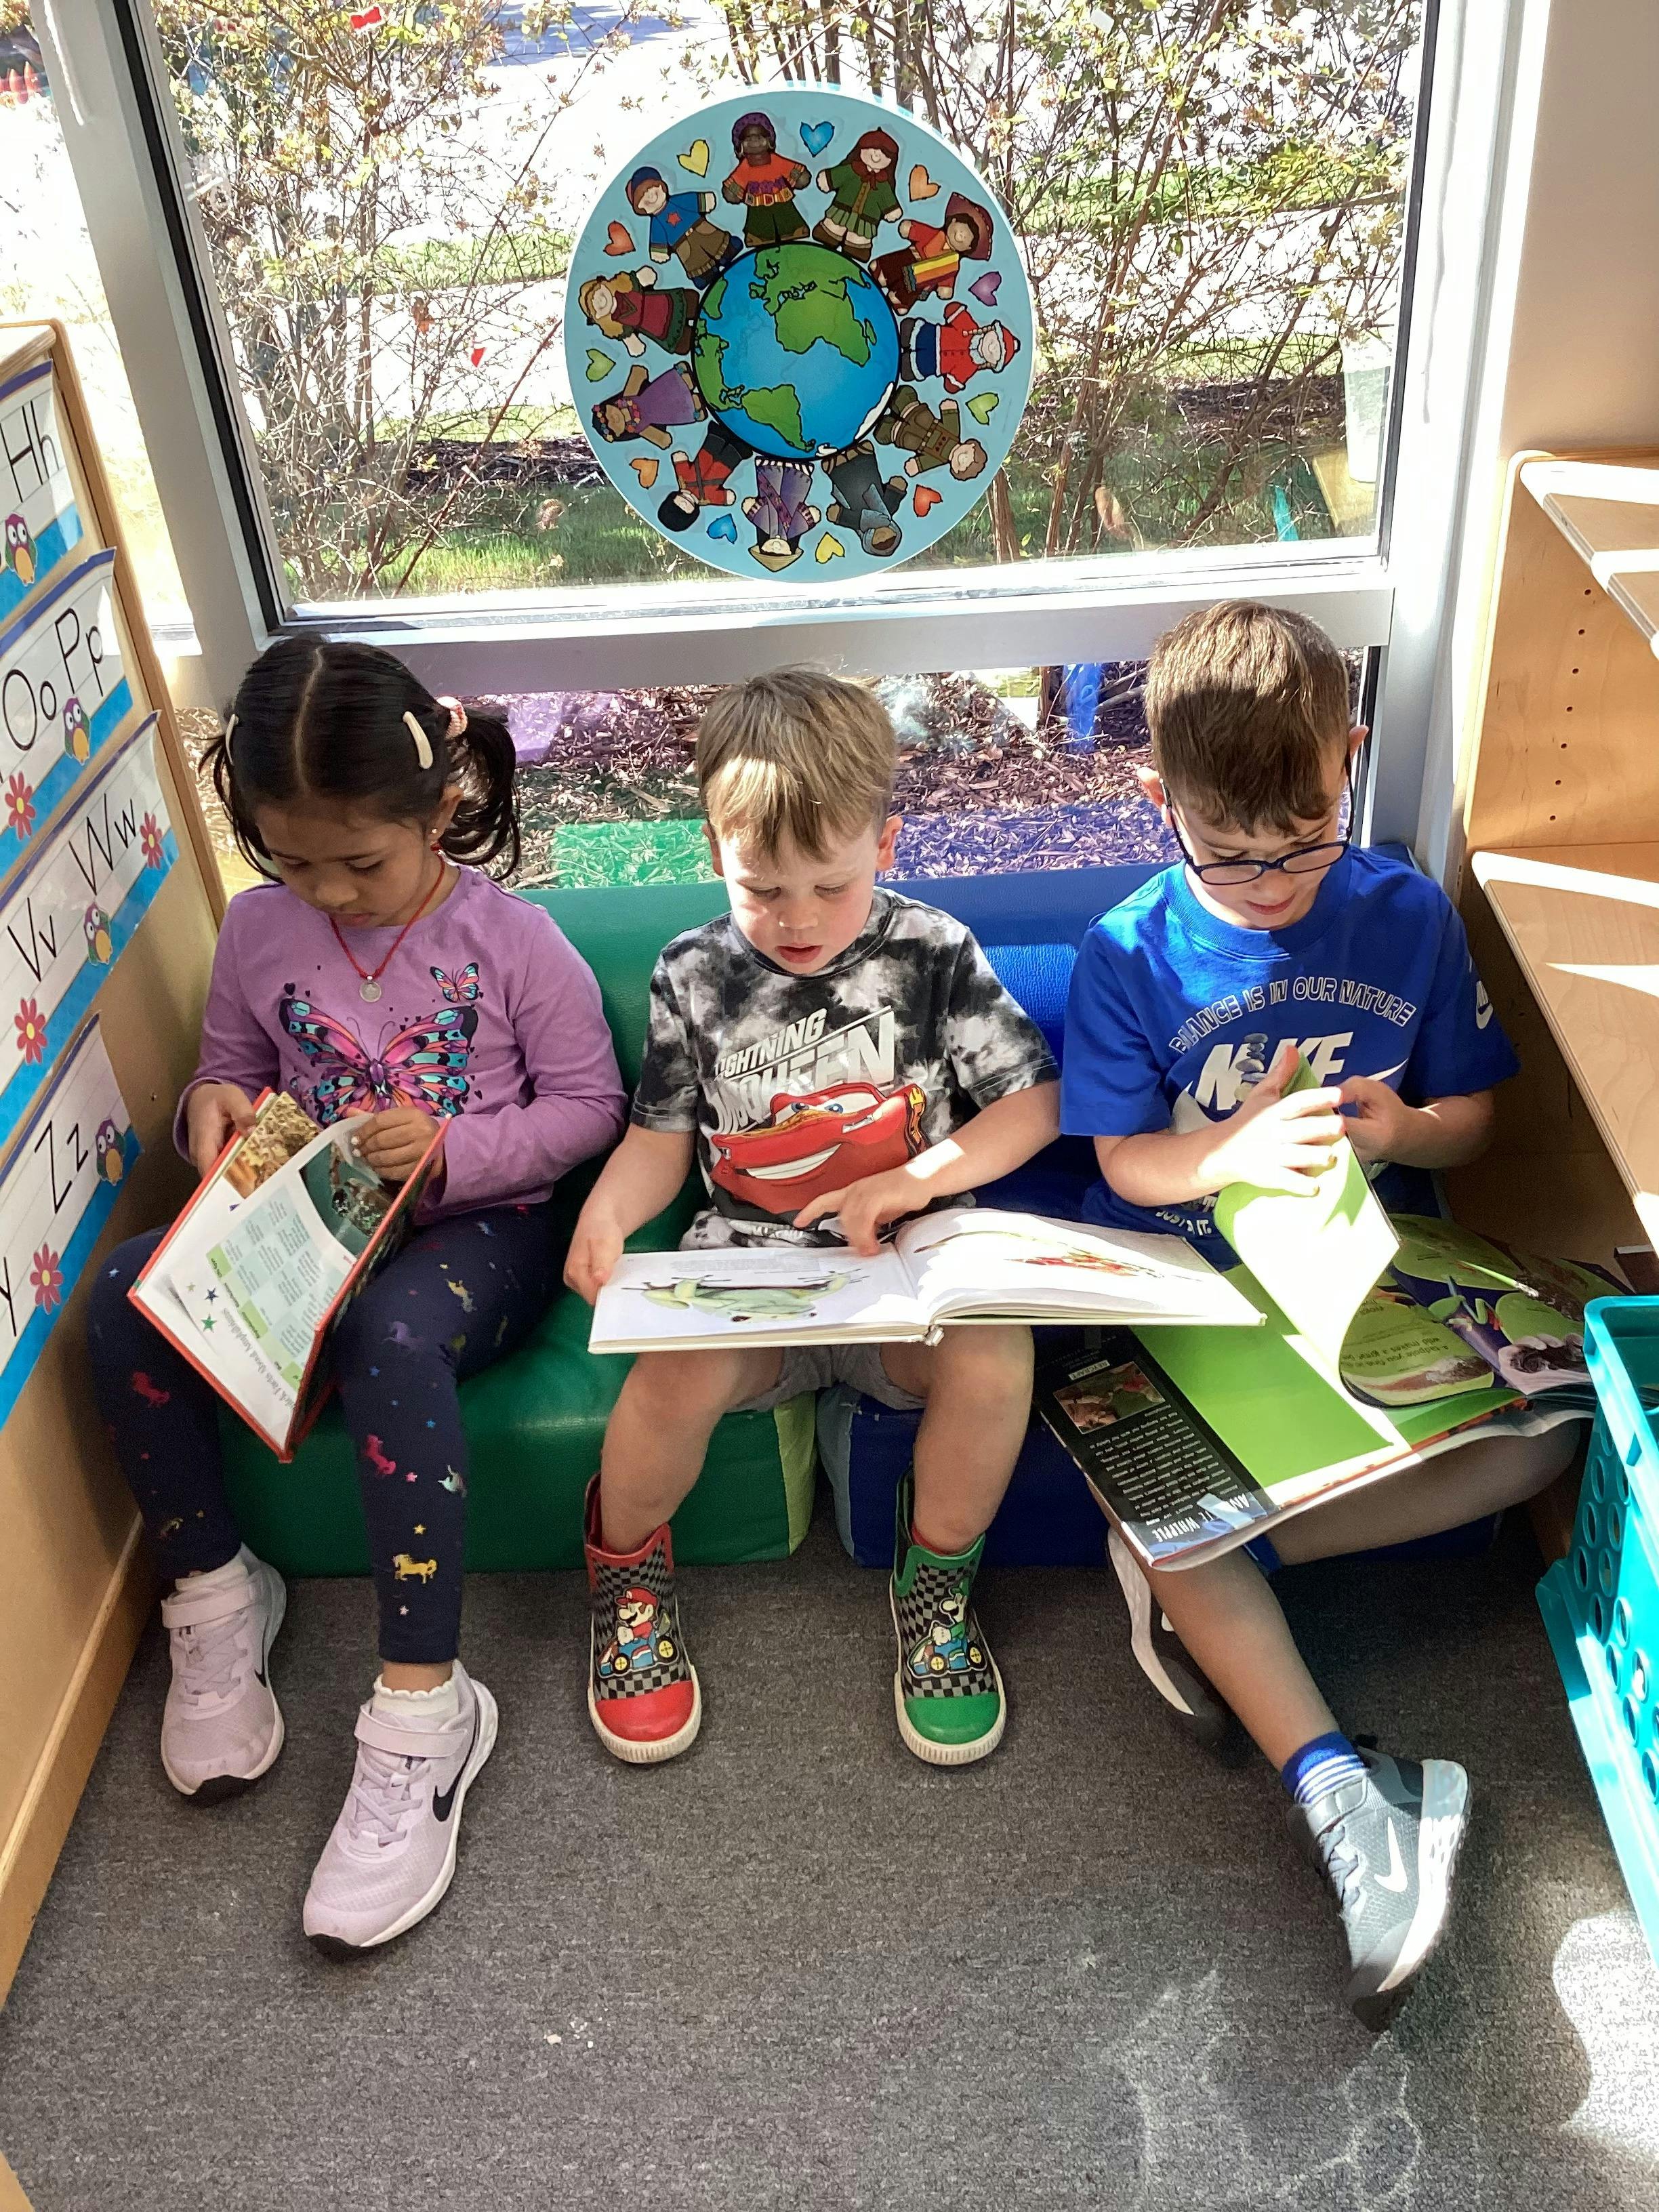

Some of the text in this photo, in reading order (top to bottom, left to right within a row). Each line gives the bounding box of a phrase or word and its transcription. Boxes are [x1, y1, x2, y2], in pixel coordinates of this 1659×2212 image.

[3, 607, 103, 751] Oo Pp
[7, 793, 136, 982] Vv Ww
[1242, 985, 1267, 1012] IS
[1269, 979, 1288, 1005] IN
[1292, 976, 1338, 1002] OUR
[1338, 979, 1417, 1027] NATURE
[34, 1120, 89, 1214] Zz
[1152, 1517, 1200, 1542] WHIPPLE
